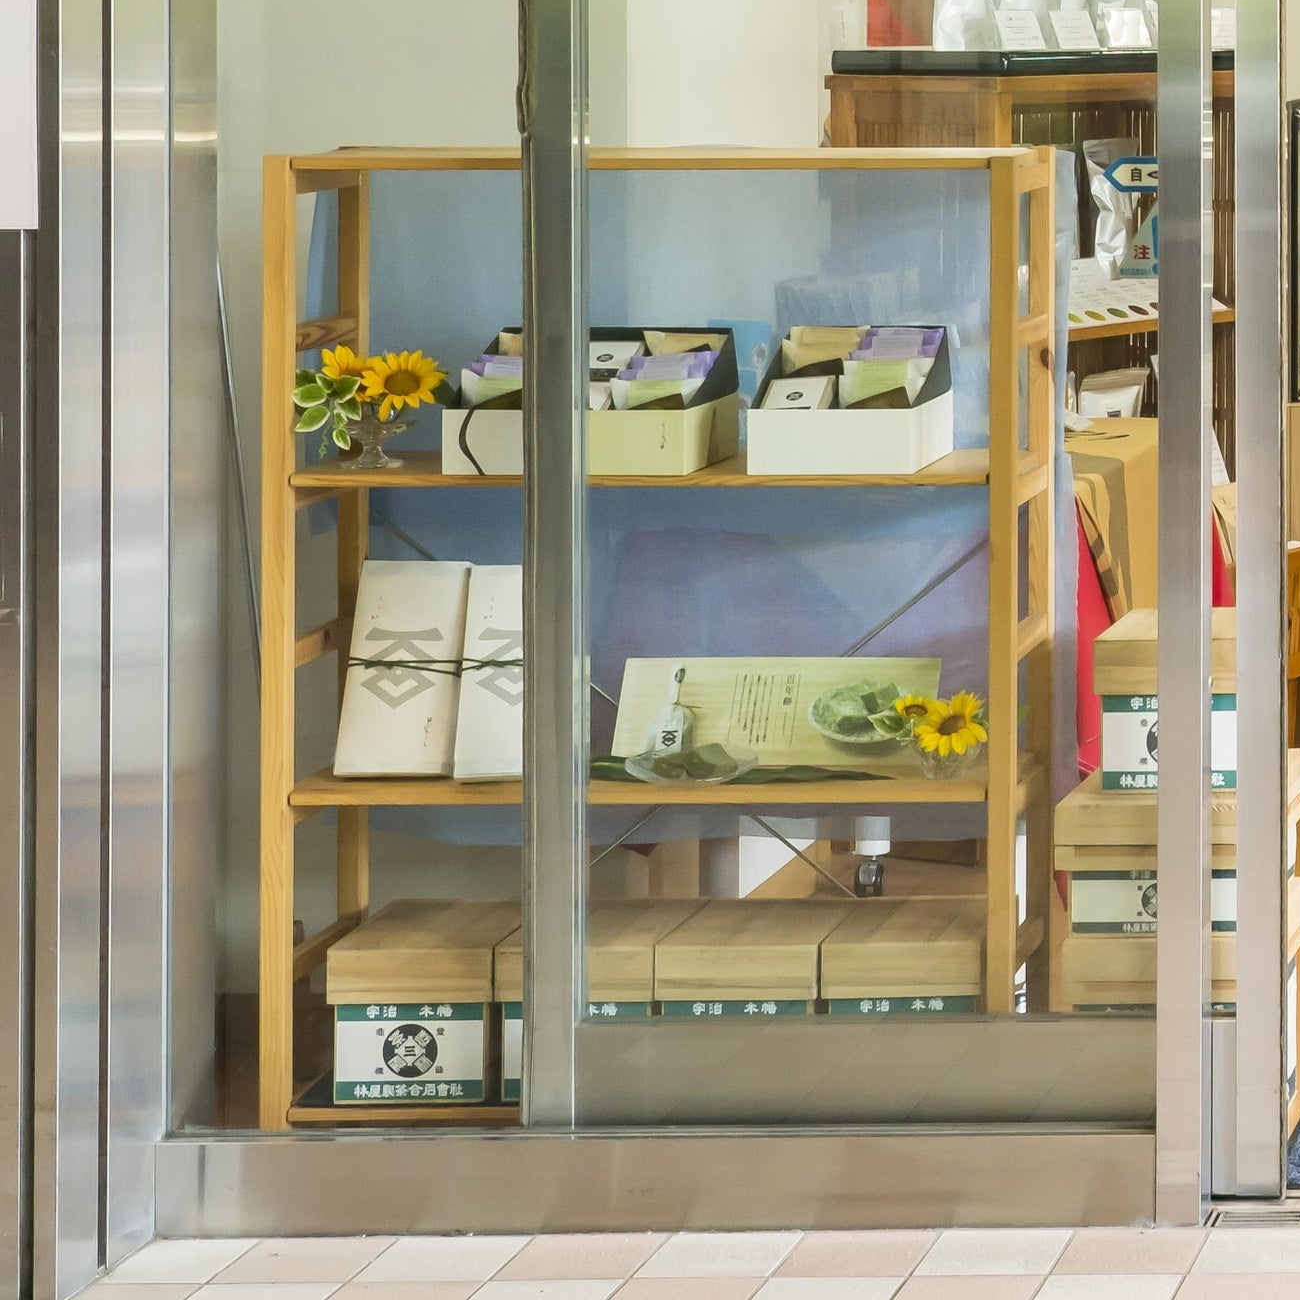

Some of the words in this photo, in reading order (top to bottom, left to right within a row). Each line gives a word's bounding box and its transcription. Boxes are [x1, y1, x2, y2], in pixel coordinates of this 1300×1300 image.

[1133, 244, 1151, 260] 注
[366, 1004, 398, 1019] 宇治
[418, 1004, 454, 1019] 木幡
[692, 1002, 723, 1016] 宇治
[743, 1001, 778, 1016] 木幡
[859, 999, 890, 1013] 宇治
[910, 998, 945, 1012] 木幡
